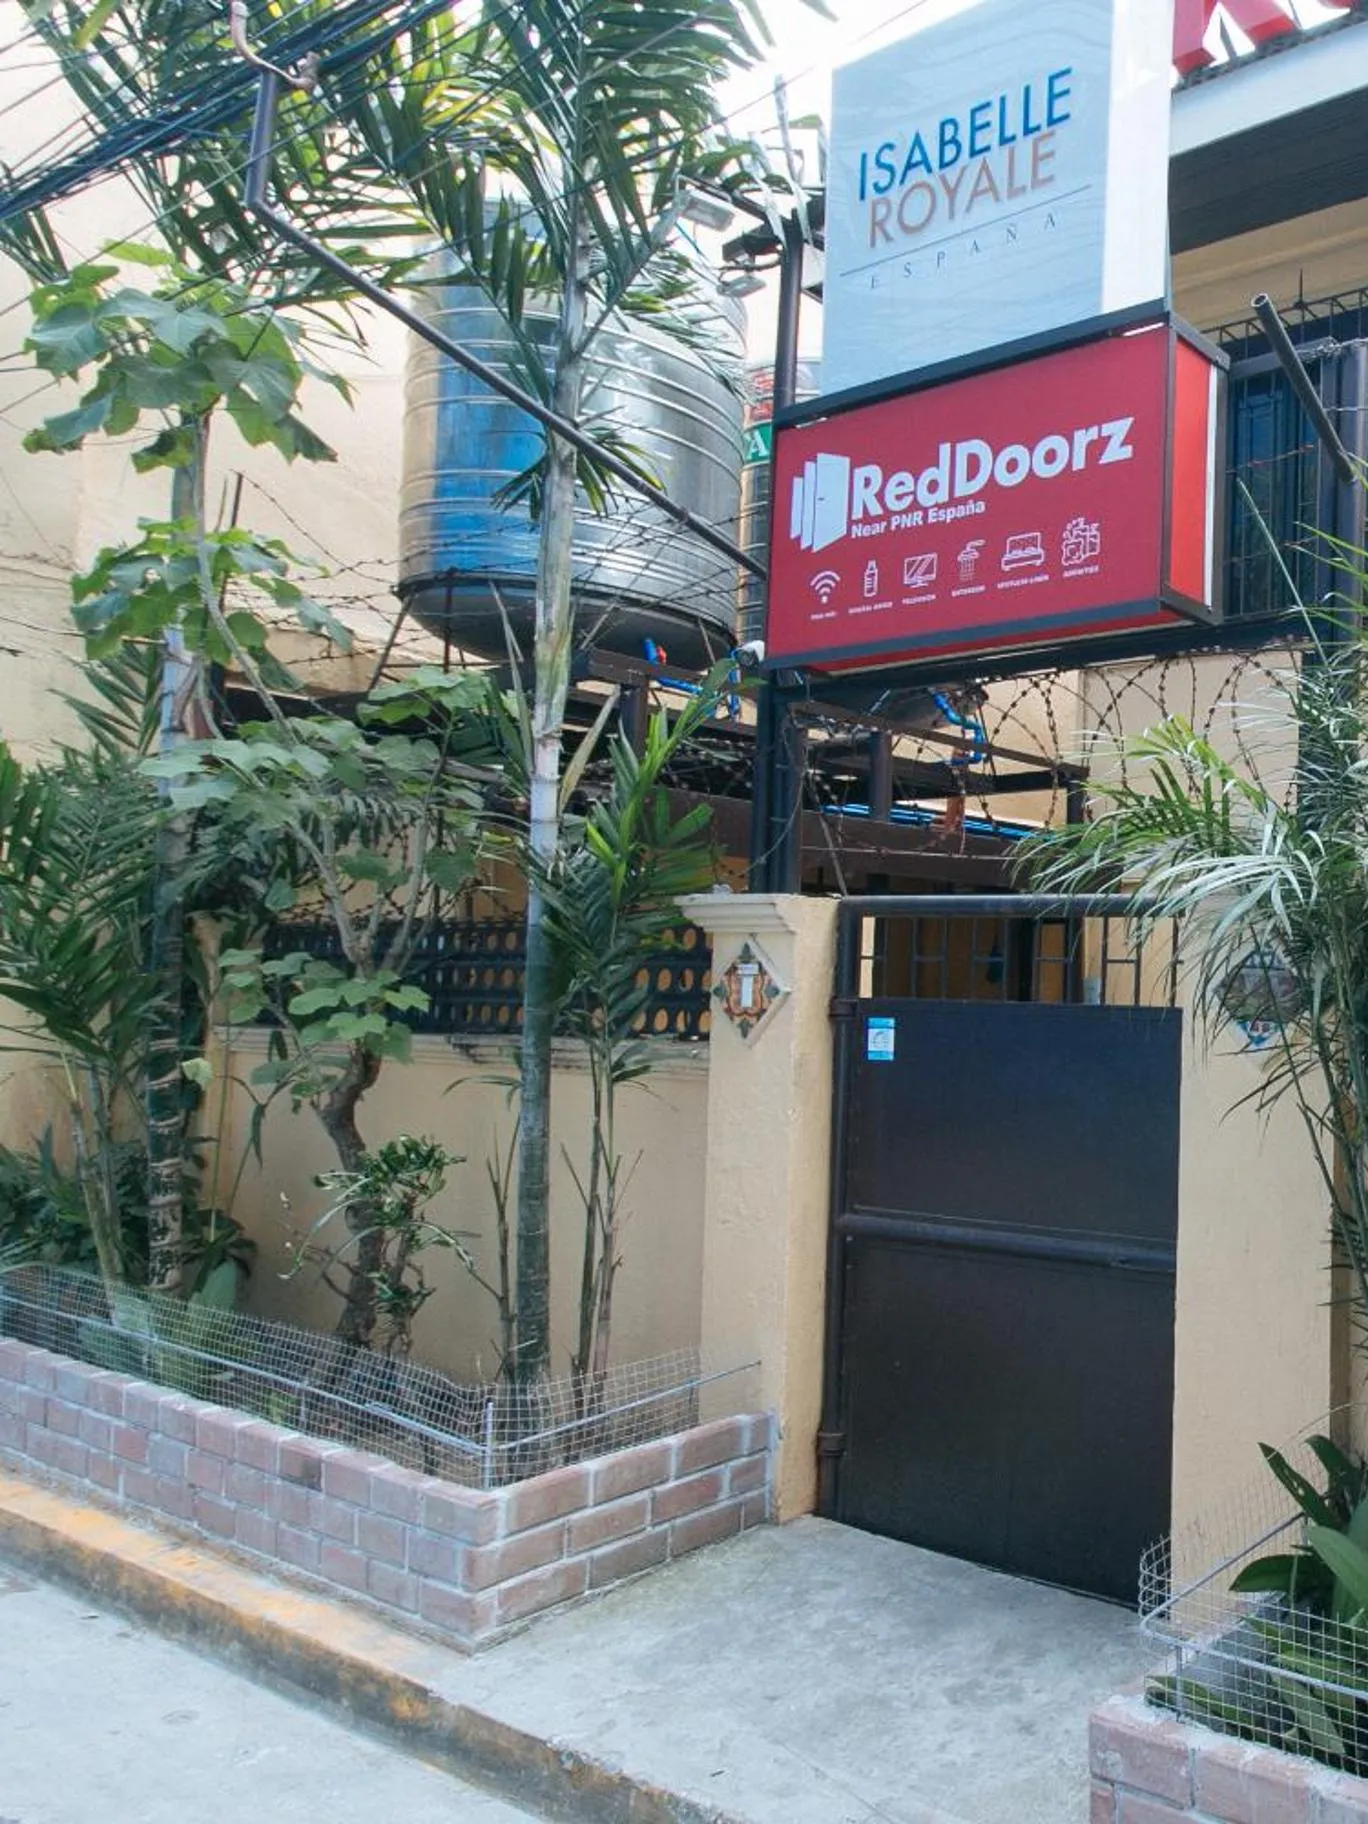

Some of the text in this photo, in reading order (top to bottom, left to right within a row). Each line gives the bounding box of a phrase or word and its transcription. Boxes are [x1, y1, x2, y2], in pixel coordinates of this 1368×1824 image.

[859, 67, 1073, 201] ISABELLE
[869, 130, 1056, 248] ROYALE
[851, 417, 1134, 520] RedDoorz
[851, 499, 986, 538] Near PNR España
